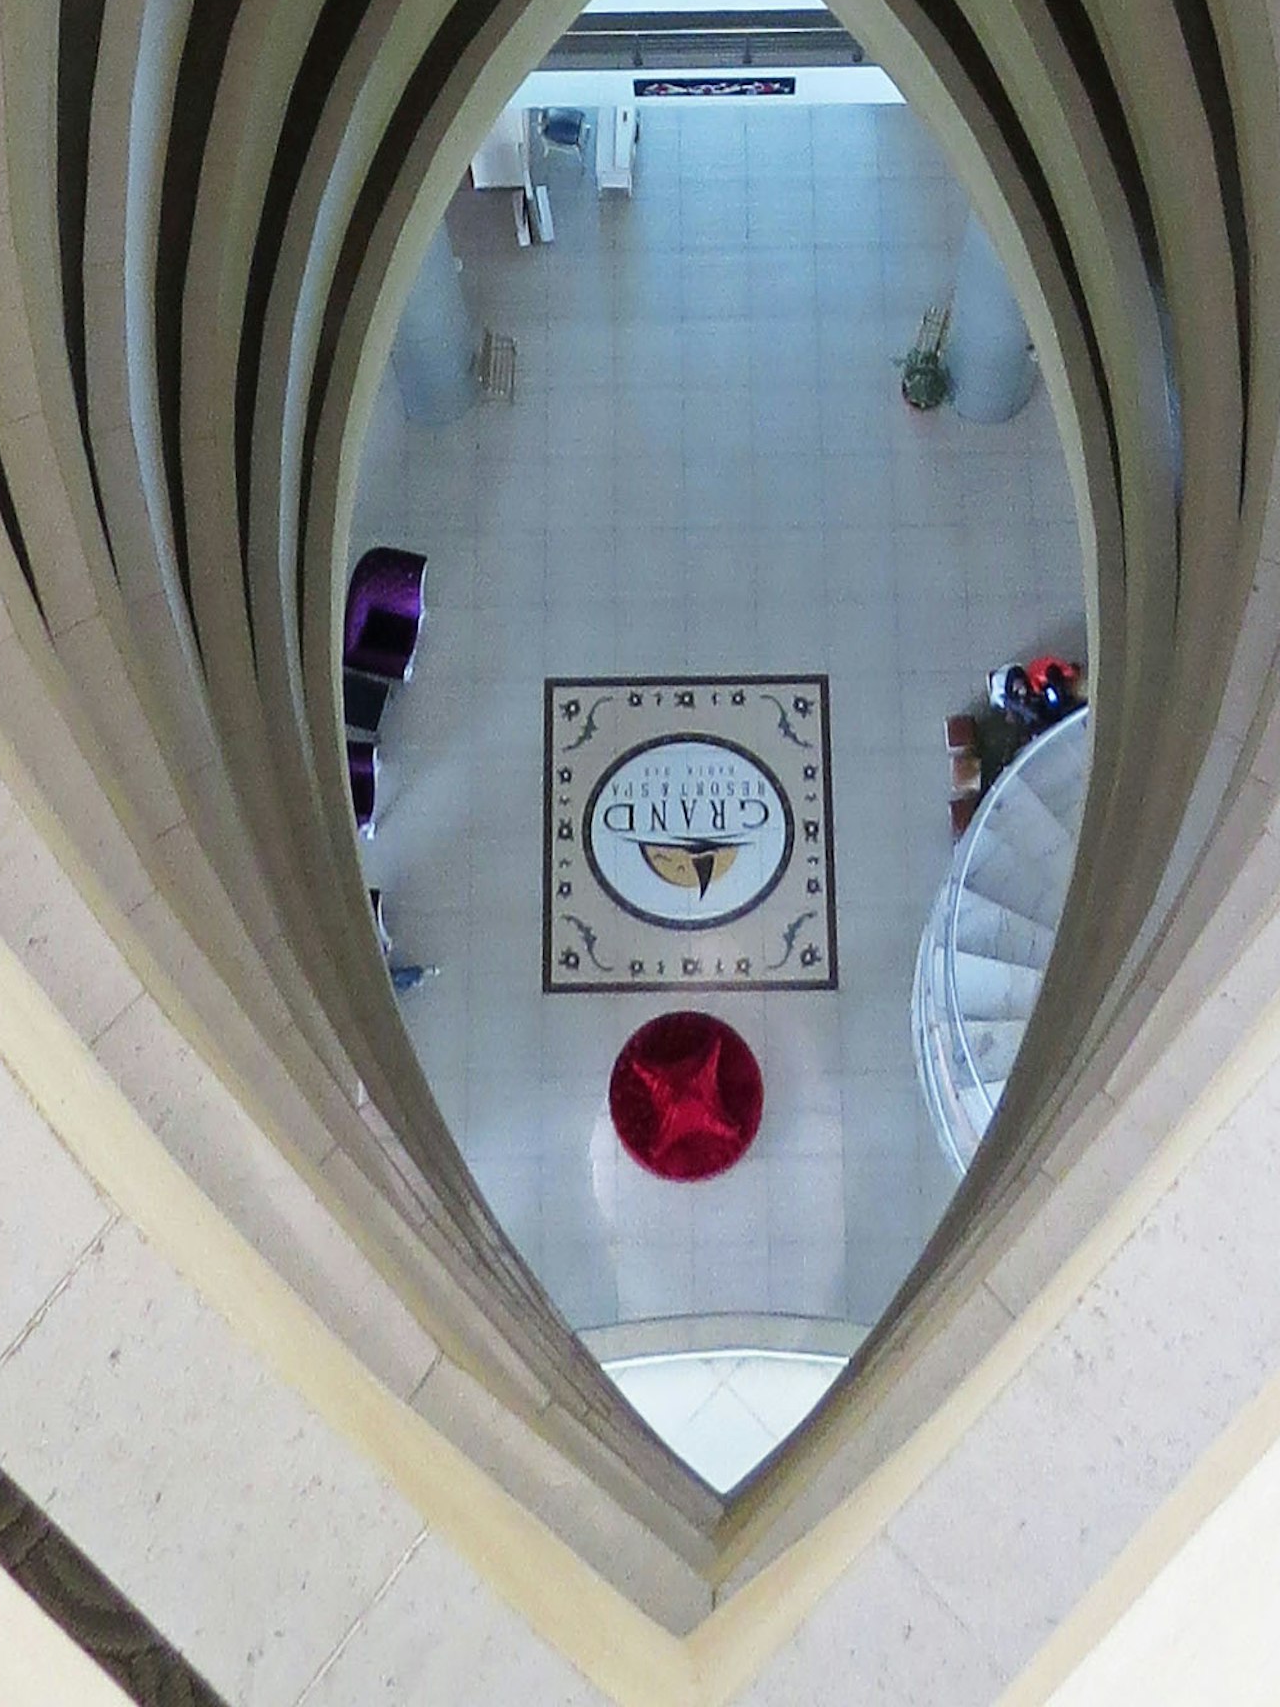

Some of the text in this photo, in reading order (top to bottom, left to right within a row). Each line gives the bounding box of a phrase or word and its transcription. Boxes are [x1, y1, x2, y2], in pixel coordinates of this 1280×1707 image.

[611, 781, 766, 798] RESORT & SPA
[603, 799, 770, 832] GRAND
